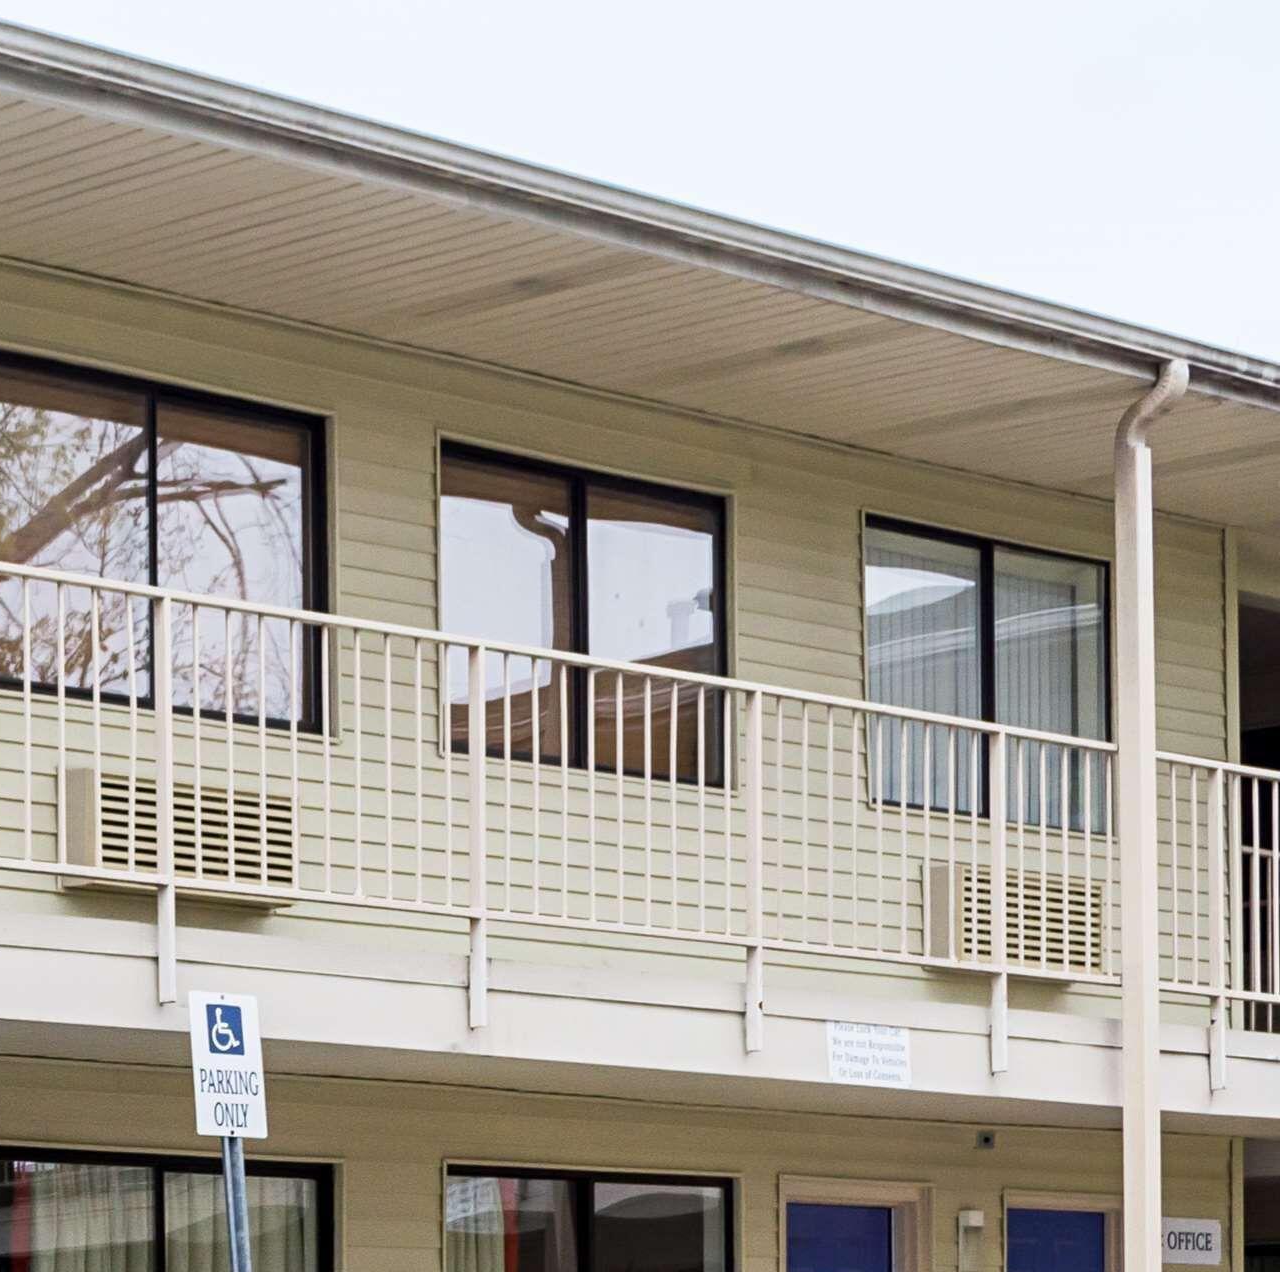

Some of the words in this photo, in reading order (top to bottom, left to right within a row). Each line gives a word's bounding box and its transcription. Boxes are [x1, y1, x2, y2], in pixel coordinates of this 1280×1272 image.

[200, 1068, 259, 1096] PARKING
[214, 1102, 249, 1128] ONLY
[1167, 1231, 1213, 1252] OFFICE
